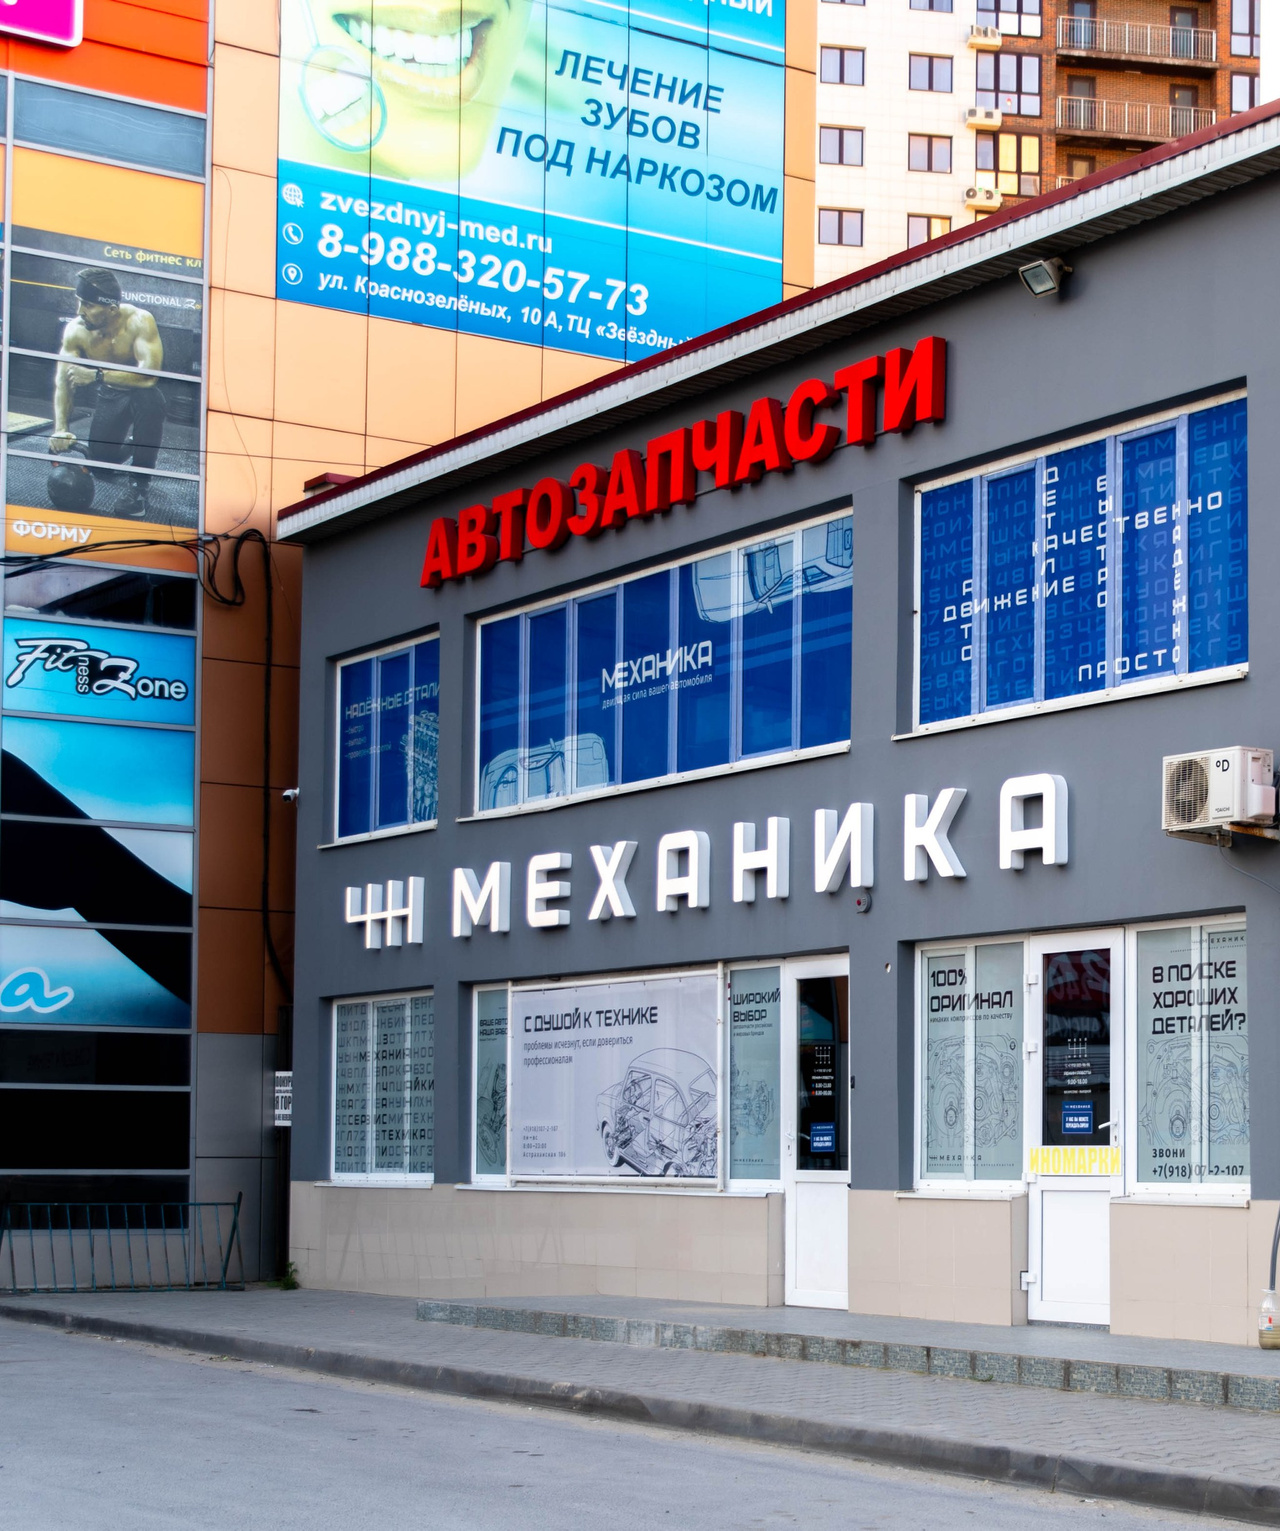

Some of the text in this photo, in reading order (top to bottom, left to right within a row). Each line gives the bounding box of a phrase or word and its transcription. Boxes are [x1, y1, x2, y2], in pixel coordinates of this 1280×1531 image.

[555, 49, 725, 115] ЛЕЧЕНИЕ
[580, 98, 701, 150] ЗУБОВ
[496, 127, 779, 214] ПОД НАРКОЗОМ
[320, 191, 552, 254] zvezdnyj-med.ru
[104, 245, 132, 260] Сеть
[135, 250, 182, 265] фитнес
[317, 225, 650, 316] 8-988-320-57-73
[318, 269, 348, 294] ул.
[355, 278, 513, 324] Краснозелёных,
[521, 306, 541, 325] 10
[566, 314, 591, 338] ТЦ
[420, 336, 947, 589] АВТОЗАПЧАСТИ
[13, 519, 92, 543] ФОРМУ
[1032, 491, 1222, 557] КАЧЕСТВЕННО
[943, 576, 1075, 623] ДВИЖЕНИЕ
[602, 640, 713, 693] МЕХАНИКА
[1078, 645, 1182, 682] ПРОСТО
[632, 688, 647, 701] сила
[671, 673, 713, 691] автомобиля
[452, 773, 1069, 938] МЕХАНИКА
[930, 968, 967, 988] 100%
[1152, 960, 1236, 984] В ПОИСКЕ
[733, 988, 780, 1005] ШИРОКИЙ
[930, 990, 1013, 1013] ОРИГИНАЛ
[1152, 986, 1238, 1009] ХОРОШИХ
[525, 1006, 659, 1033] С ДУШОЙ К ТЕХНИКЕ
[733, 1009, 767, 1022] ВЫБОР
[991, 1012, 1013, 1020] качеству
[1151, 1009, 1246, 1035] ДЕТАЛЕЙ?
[524, 1040, 553, 1053] проблемы
[582, 1037, 596, 1048] если
[597, 1035, 633, 1049] довериться
[524, 1055, 573, 1068] профессионалам
[1029, 1148, 1121, 1175] ИНОМАРКИ
[1152, 1148, 1186, 1159] ЗВОНИ
